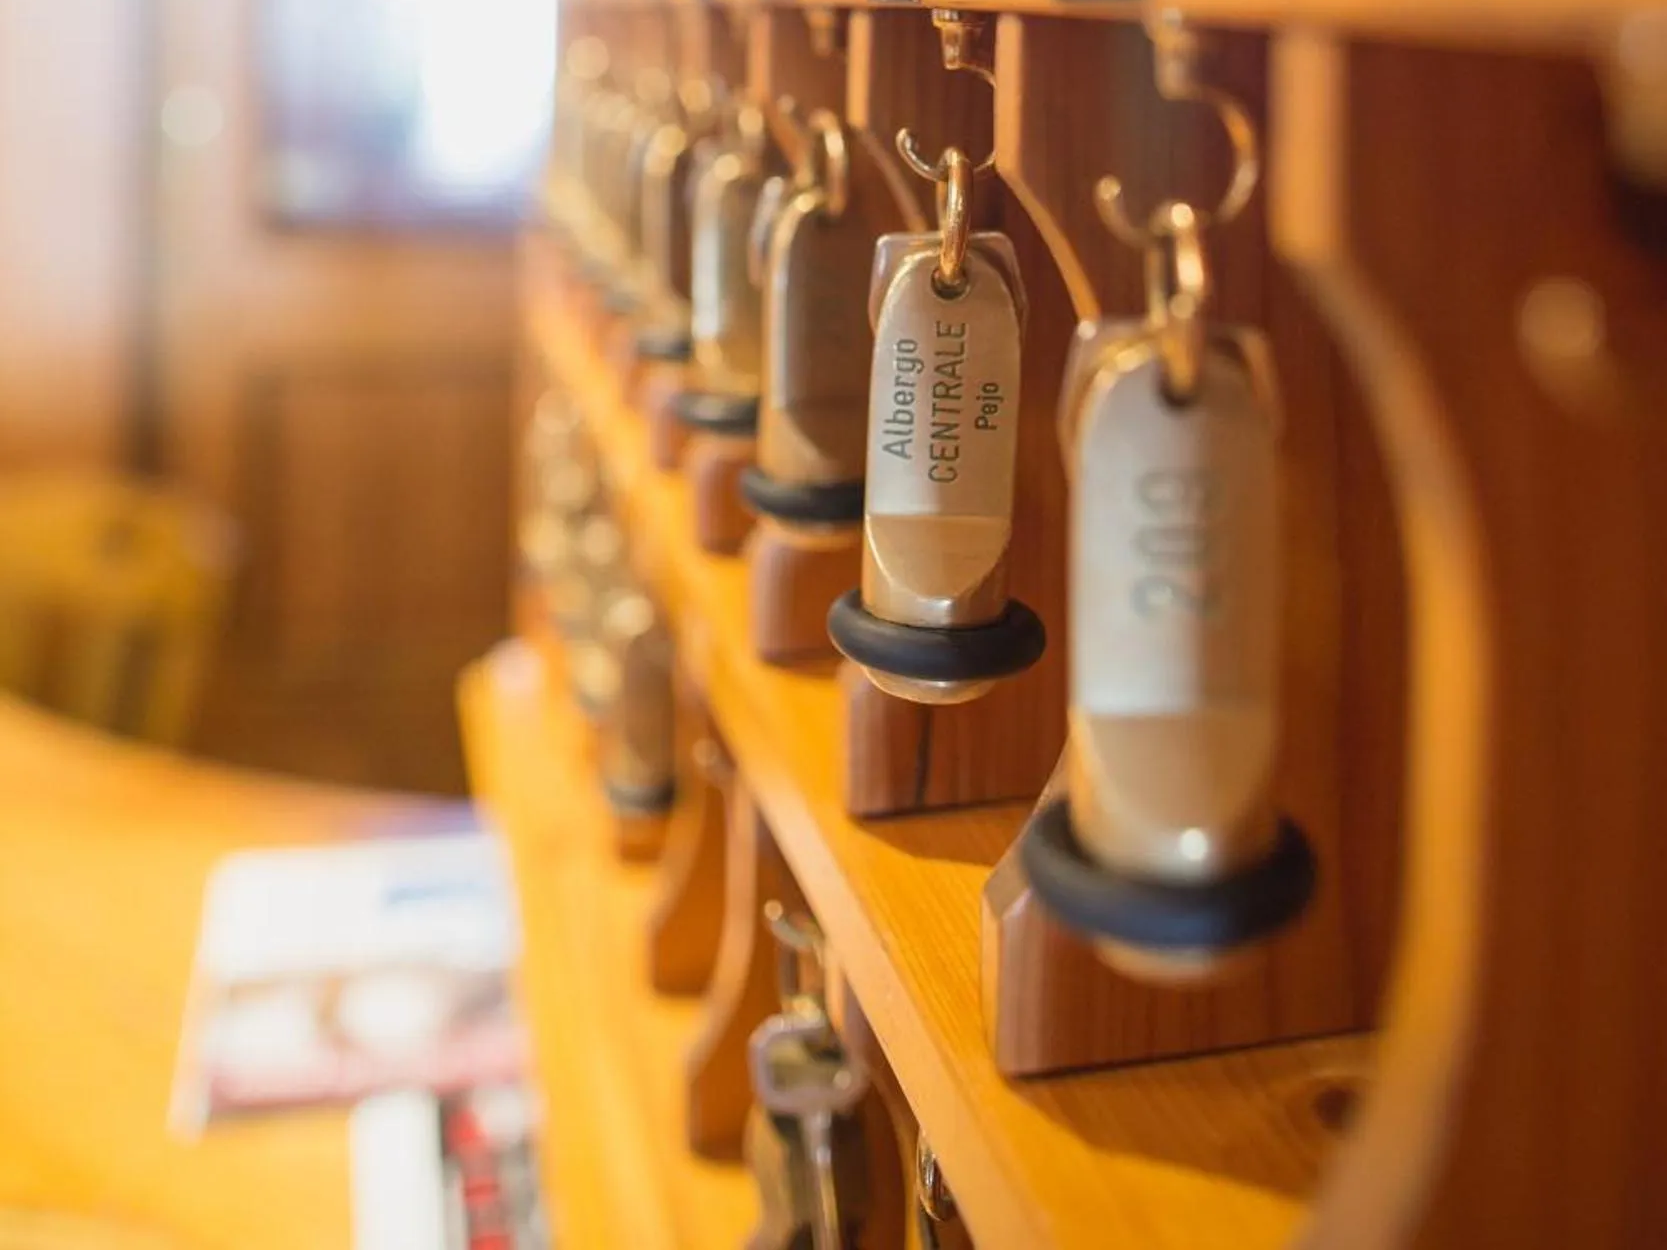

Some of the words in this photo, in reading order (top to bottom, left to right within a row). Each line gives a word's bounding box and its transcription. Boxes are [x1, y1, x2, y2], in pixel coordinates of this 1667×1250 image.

[882, 339, 925, 461] Albergo
[928, 320, 967, 483] CENTRALE
[974, 382, 1005, 431] Pejo
